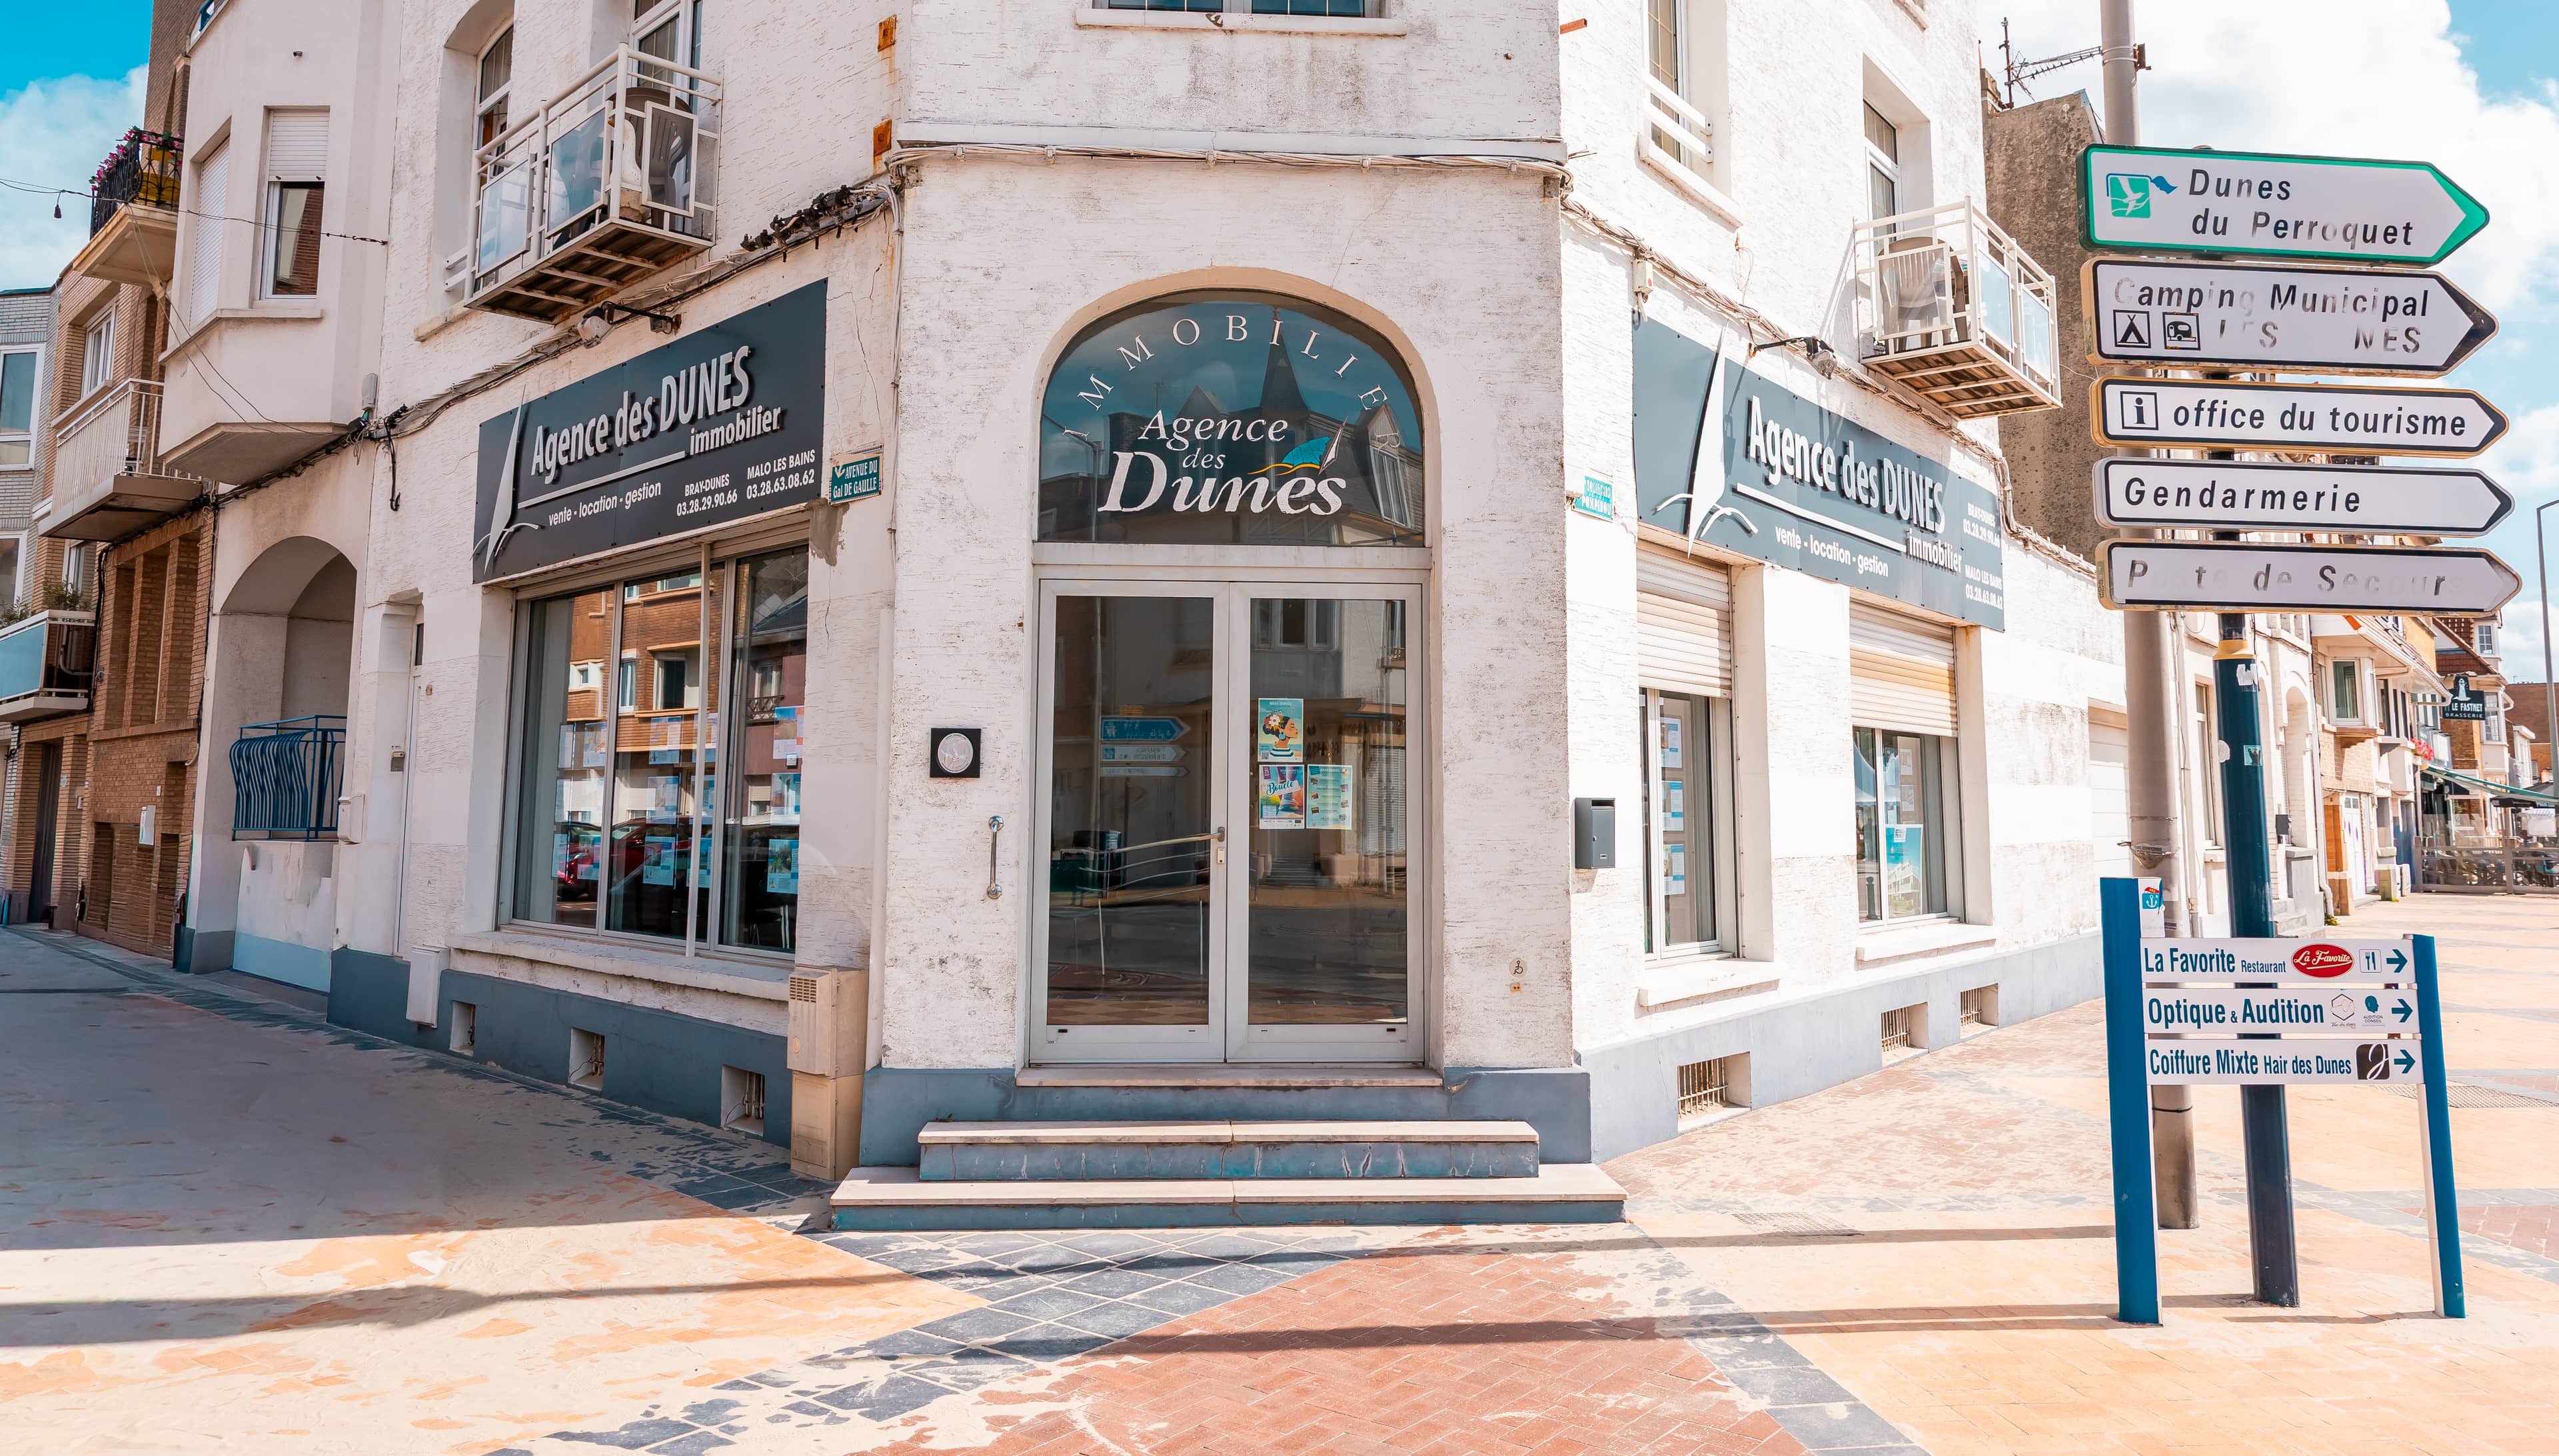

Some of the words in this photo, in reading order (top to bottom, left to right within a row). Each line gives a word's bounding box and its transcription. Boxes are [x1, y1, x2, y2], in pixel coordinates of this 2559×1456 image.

[2189, 169, 2291, 201] Dunes
[2192, 208, 2228, 237] du
[2252, 211, 2413, 250] Perroquet
[2115, 277, 2254, 317] Camping
[2270, 284, 2428, 322] Municipal
[530, 412, 608, 484] Agence
[615, 390, 653, 446] des
[660, 345, 750, 432] DUNES
[690, 405, 782, 456] immobilier
[1138, 410, 1287, 451] Agence
[2174, 399, 2264, 430] office
[2280, 402, 2314, 431] du
[2330, 406, 2466, 436] tourisme
[747, 462, 770, 480] MALO
[773, 458, 787, 474] LES
[789, 450, 815, 470] BAINS
[845, 462, 868, 479] AVENUE
[869, 460, 878, 474] DU
[1183, 448, 1226, 470] des
[1750, 396, 1836, 492] Agence
[1843, 440, 1879, 508] des
[1883, 458, 1945, 534] DUNES
[685, 474, 730, 496] BRAY-DUNES
[746, 468, 815, 500] 03.28.63.08.62
[844, 482, 852, 496] DE
[854, 477, 877, 494] GAULLE
[1098, 450, 1346, 516] Dunes
[2125, 477, 2360, 512] Gendarmerie
[548, 508, 571, 526] vente
[579, 494, 617, 517] location
[624, 481, 661, 510] gestion
[676, 490, 738, 516] 03.28.29.90.66
[1775, 525, 1802, 550] vente
[1810, 538, 1850, 566] location
[1858, 553, 1889, 578] gestion
[1908, 528, 1962, 573] immobilier
[2144, 948, 2164, 972] La
[2170, 948, 2235, 973] Favorite
[2241, 960, 2286, 973] Restaurant
[2294, 951, 2310, 966] La
[2312, 950, 2350, 965] Favorite
[2148, 998, 2226, 1029] Optique
[2230, 1010, 2238, 1023] &
[2242, 998, 2324, 1024] Audition
[2150, 1049, 2210, 1075] Coiffure
[2216, 1049, 2258, 1075] Mixte
[2264, 1056, 2288, 1075] Hair
[2292, 1056, 2312, 1074] des
[2316, 1056, 2351, 1075] Dunes
